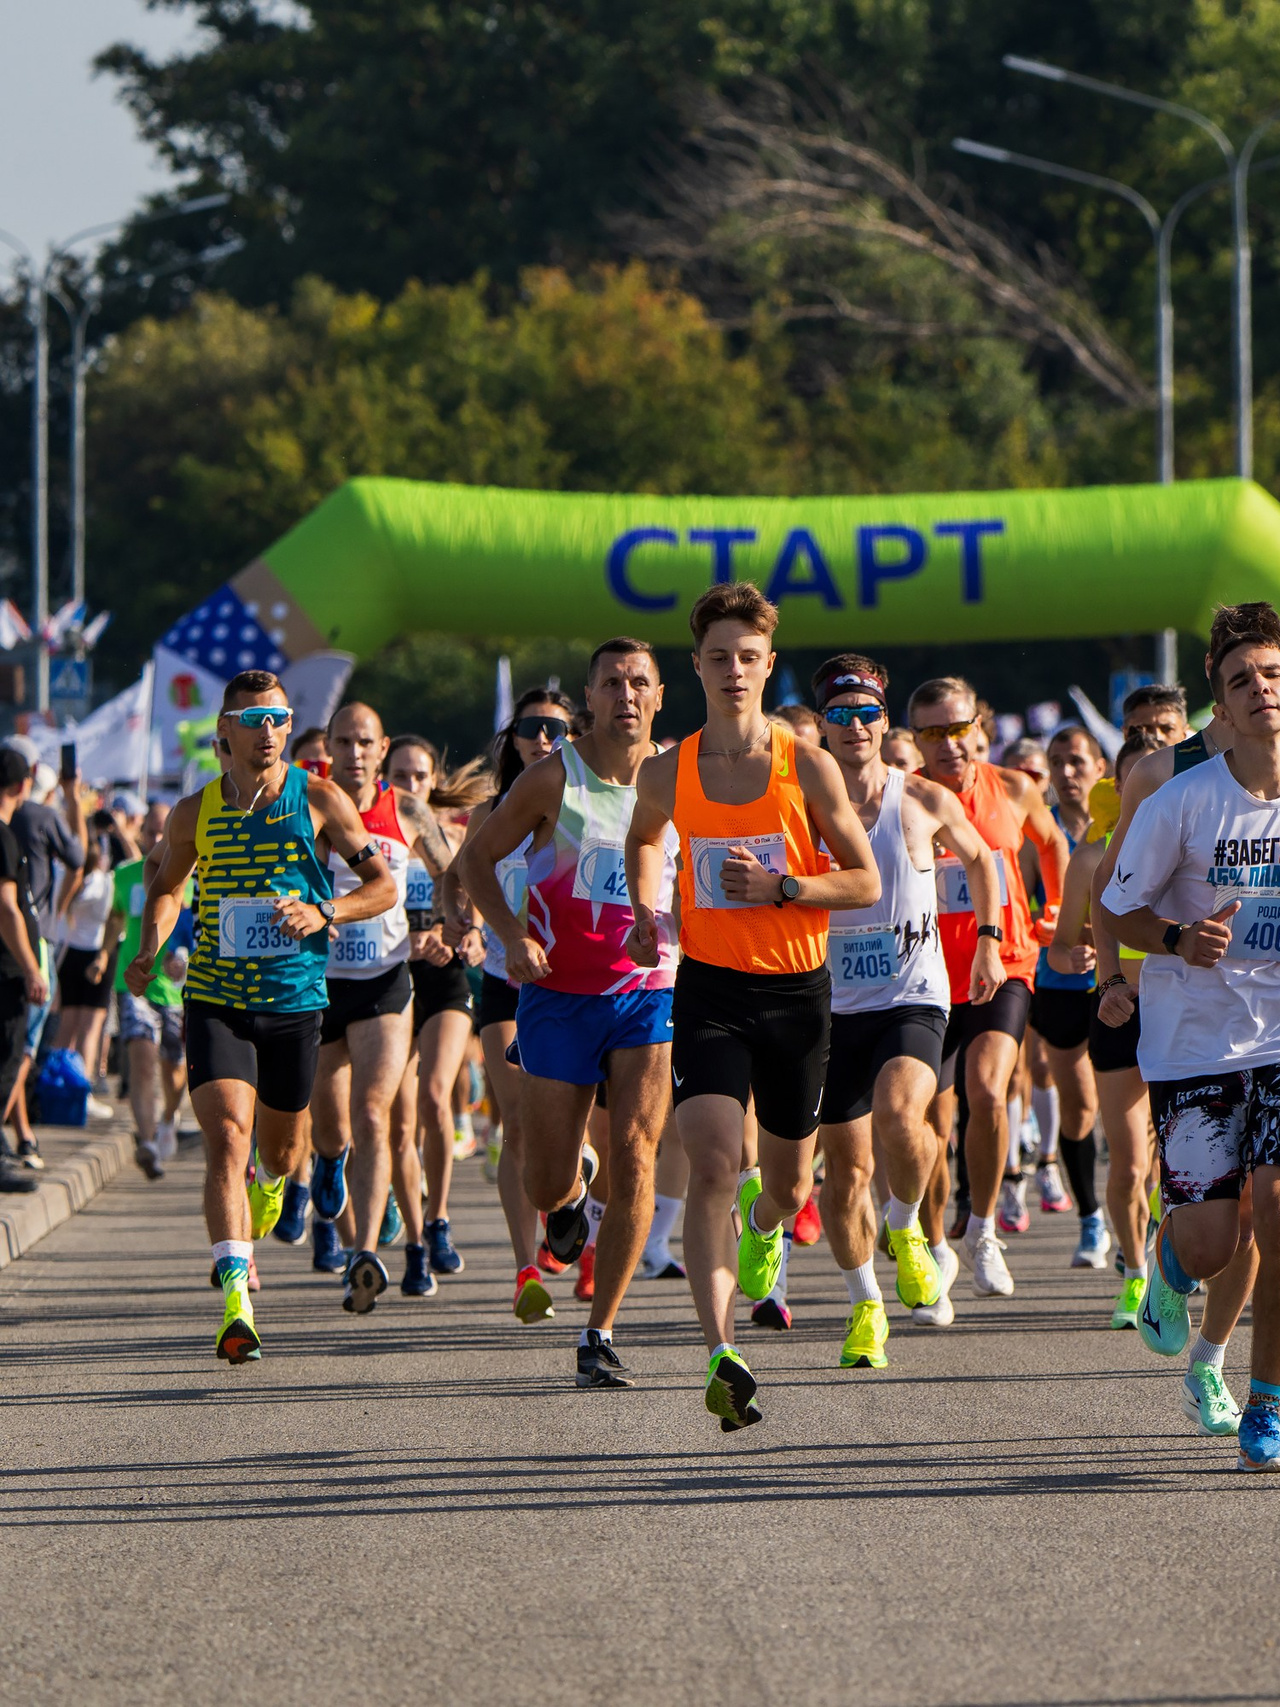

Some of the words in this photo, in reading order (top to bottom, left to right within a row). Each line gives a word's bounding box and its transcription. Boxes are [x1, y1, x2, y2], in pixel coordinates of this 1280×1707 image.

[607, 518, 1006, 612] СТАРТ
[603, 871, 628, 897] 42
[1206, 867, 1244, 888] 45%
[406, 882, 434, 903] 292
[335, 941, 377, 962] 3590
[843, 938, 883, 954] ВИТАЛИЙ
[842, 952, 892, 980] 2405
